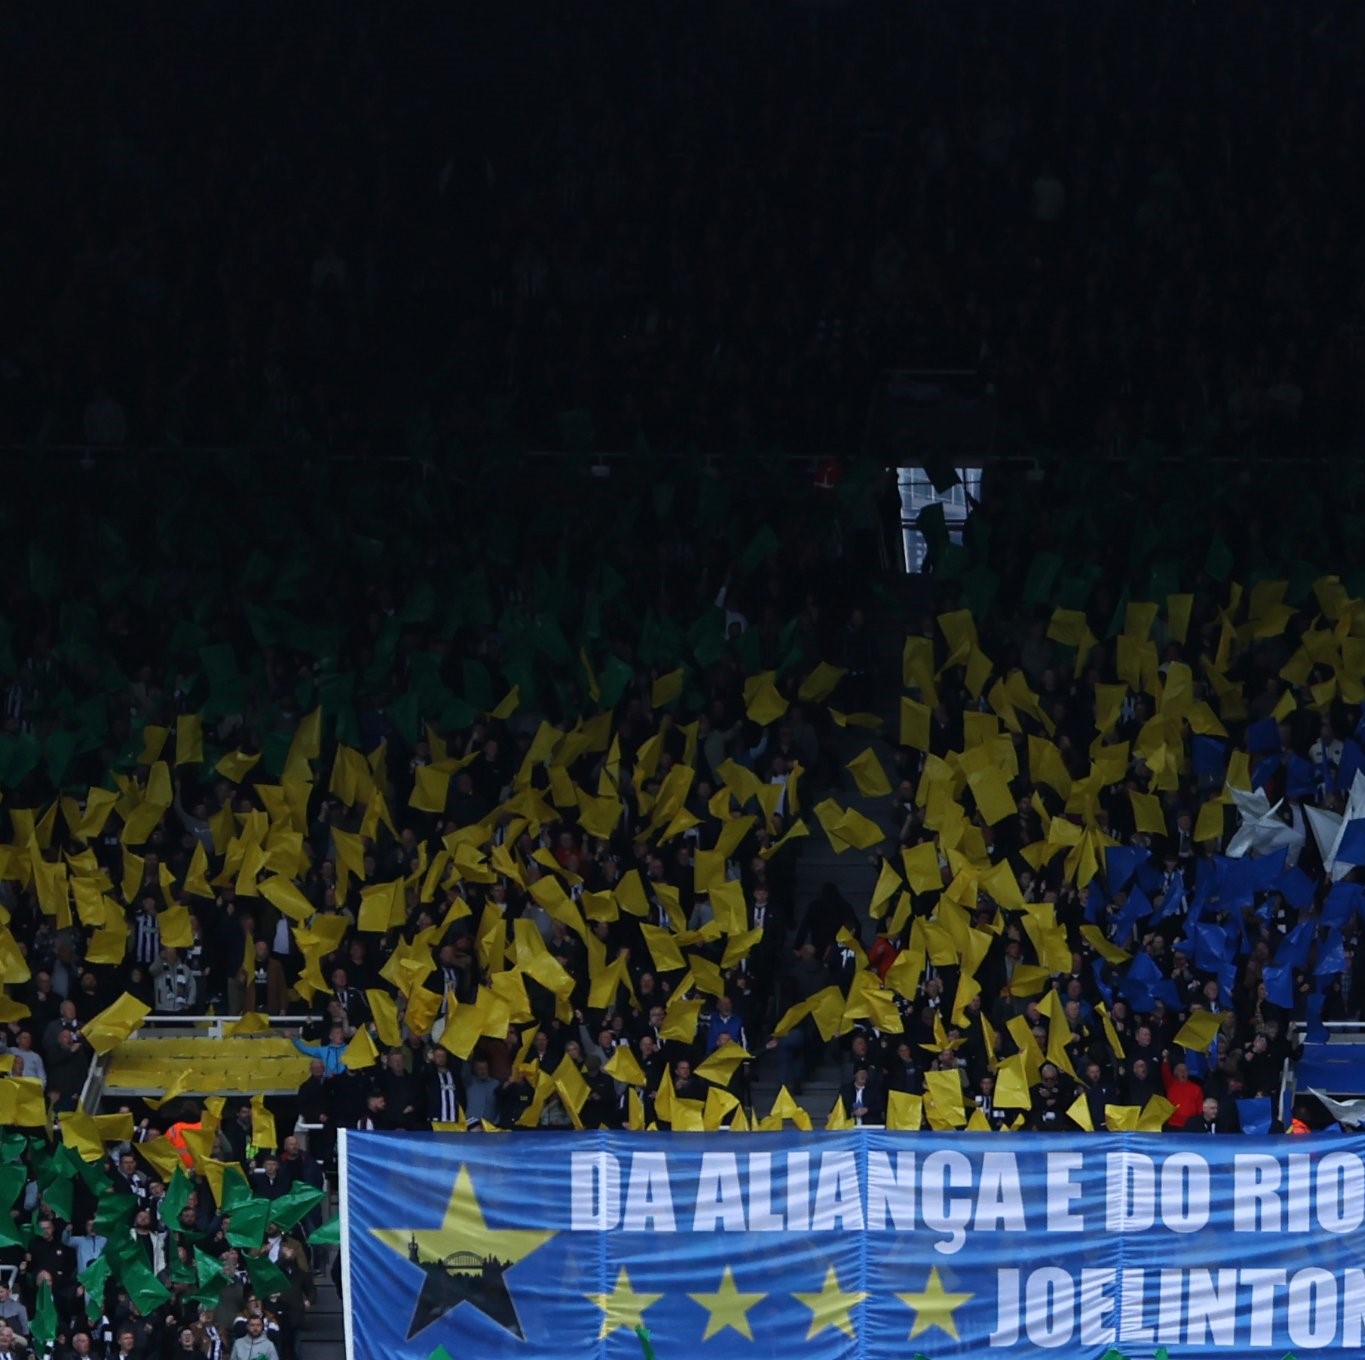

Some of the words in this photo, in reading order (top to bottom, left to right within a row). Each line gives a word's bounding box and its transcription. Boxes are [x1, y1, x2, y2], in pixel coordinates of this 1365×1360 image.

[571, 1151, 676, 1232] DA
[693, 1150, 1026, 1255] ALIANÇA
[1047, 1151, 1085, 1232] E
[1106, 1151, 1211, 1233] DO
[1234, 1152, 1365, 1234] RIO
